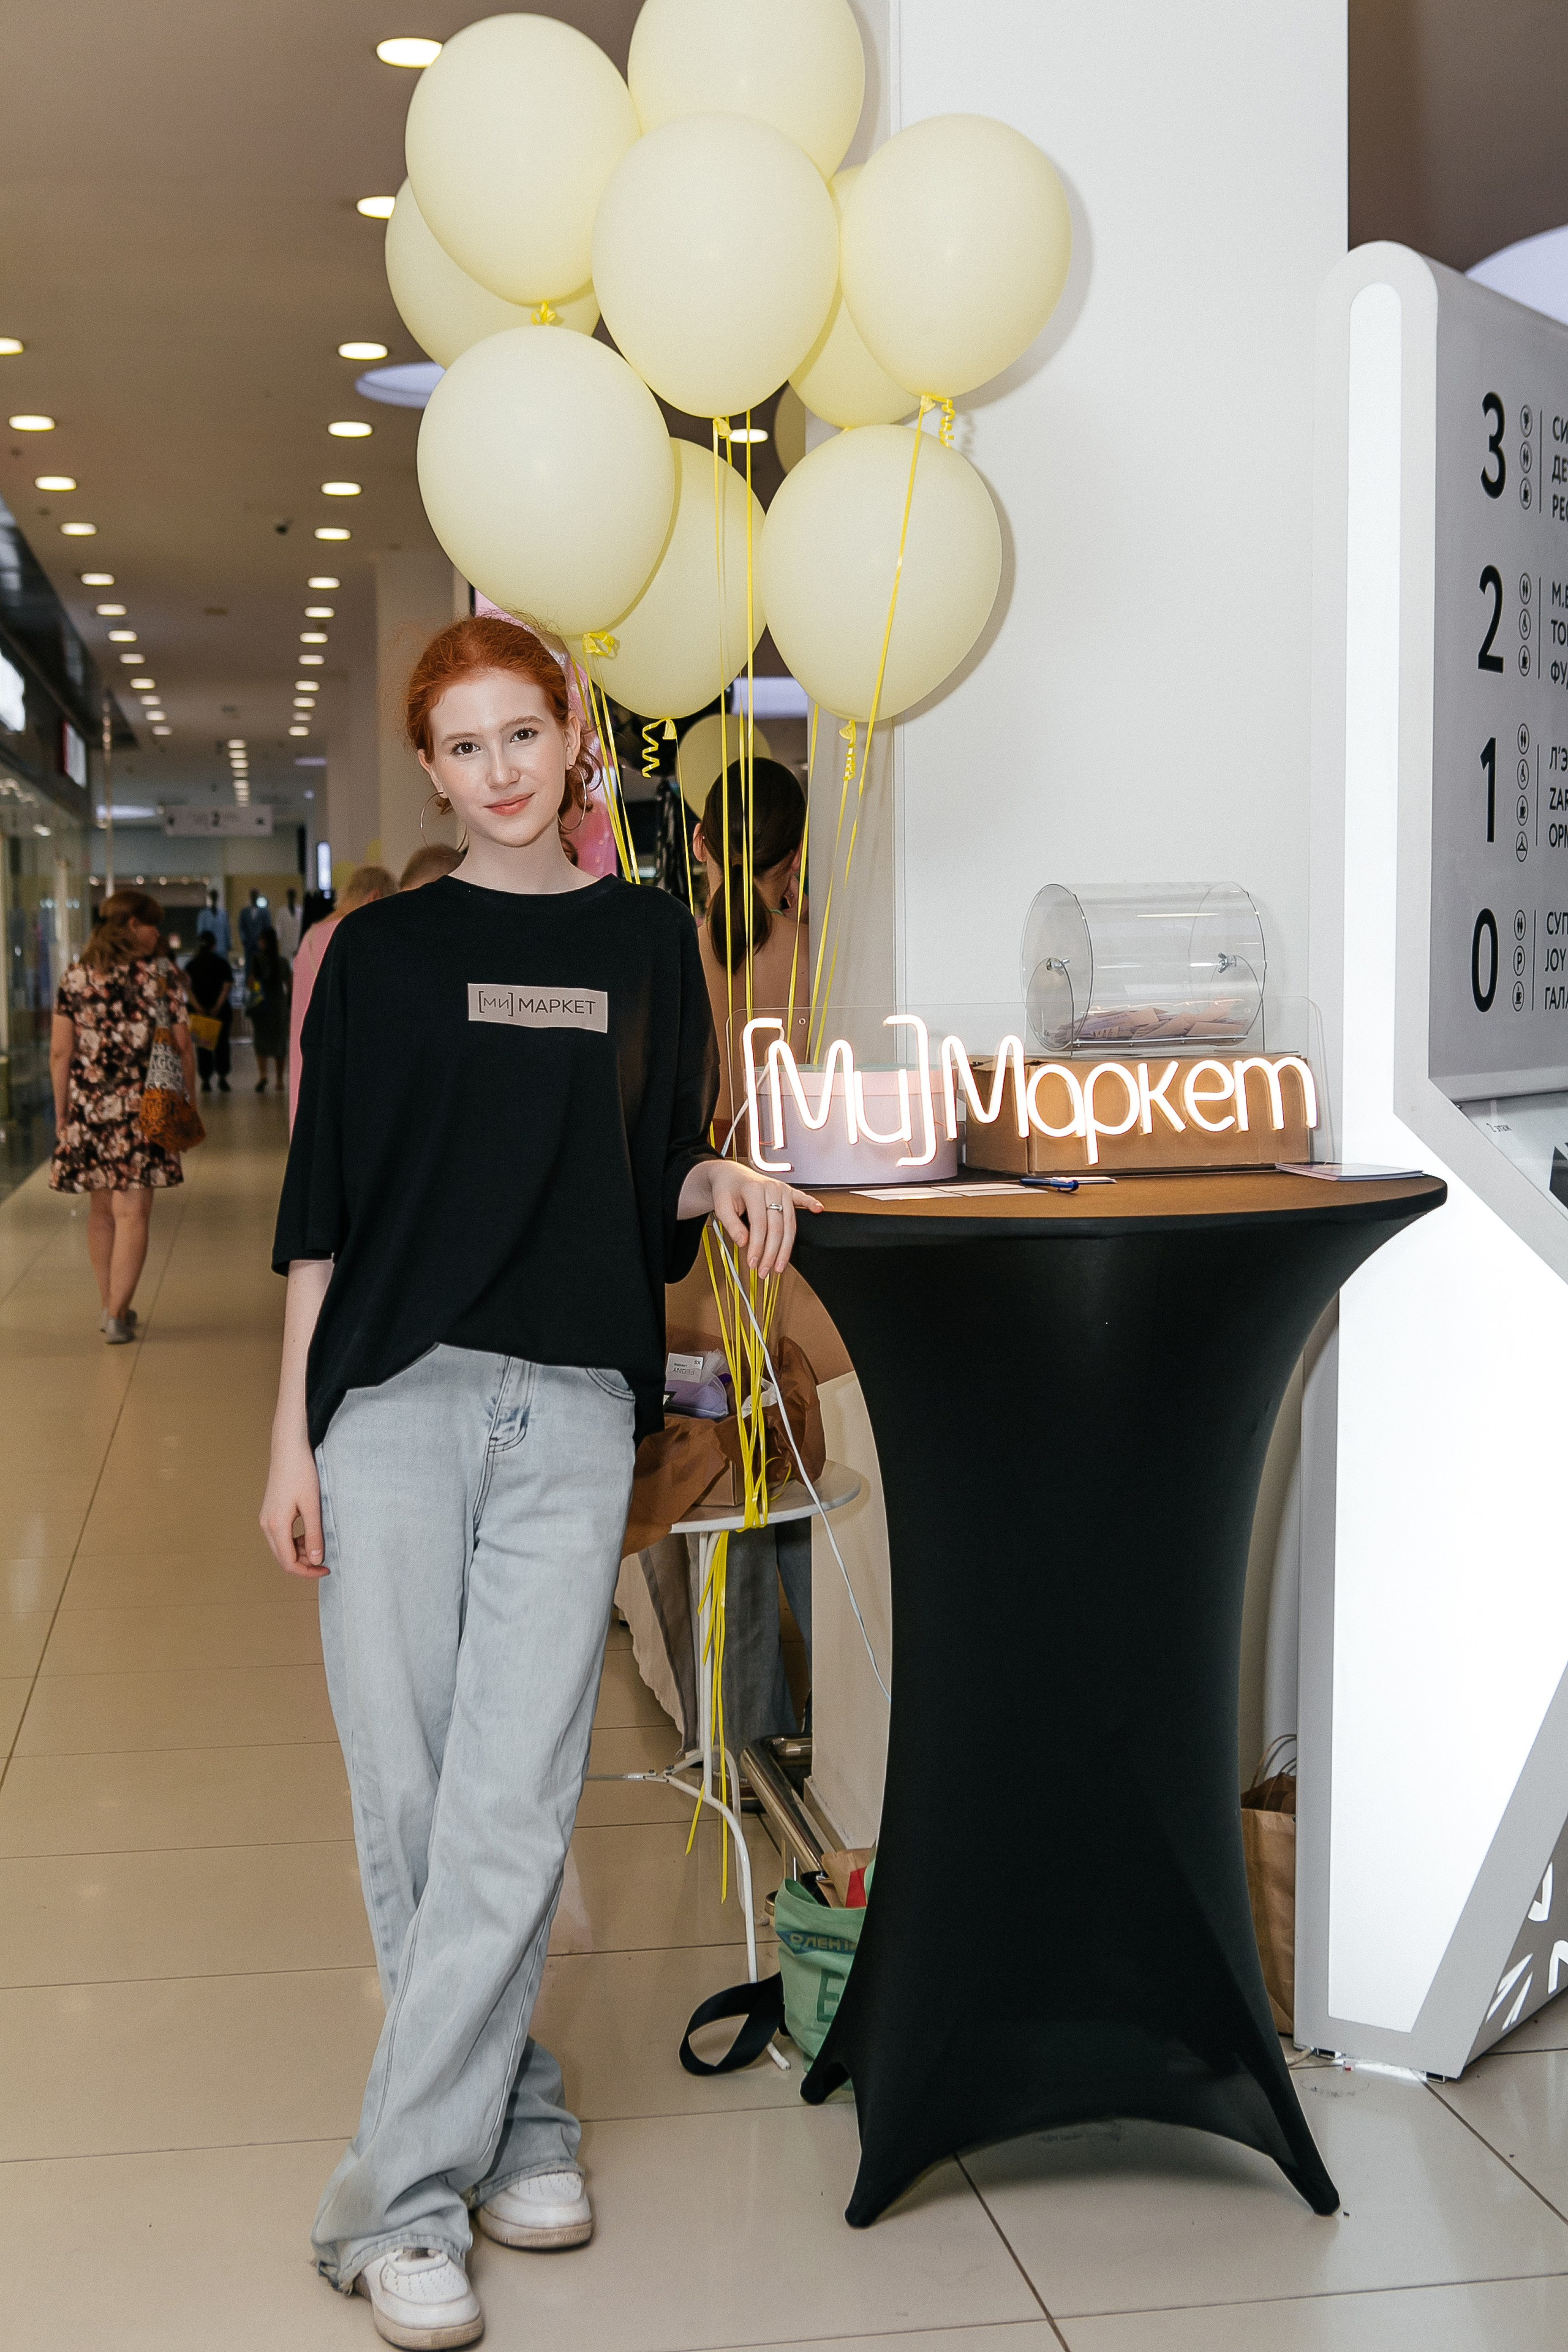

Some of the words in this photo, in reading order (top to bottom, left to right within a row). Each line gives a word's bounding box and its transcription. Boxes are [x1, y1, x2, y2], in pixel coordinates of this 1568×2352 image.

[1480, 391, 1506, 499] 3
[1551, 454, 1568, 485] ДЕ
[1478, 565, 1504, 674] 2
[1550, 619, 1568, 646] ТО
[1550, 660, 1568, 690] ФУ
[1480, 737, 1496, 843] 1
[1472, 908, 1499, 1013] 0
[1545, 948, 1567, 972] JOY
